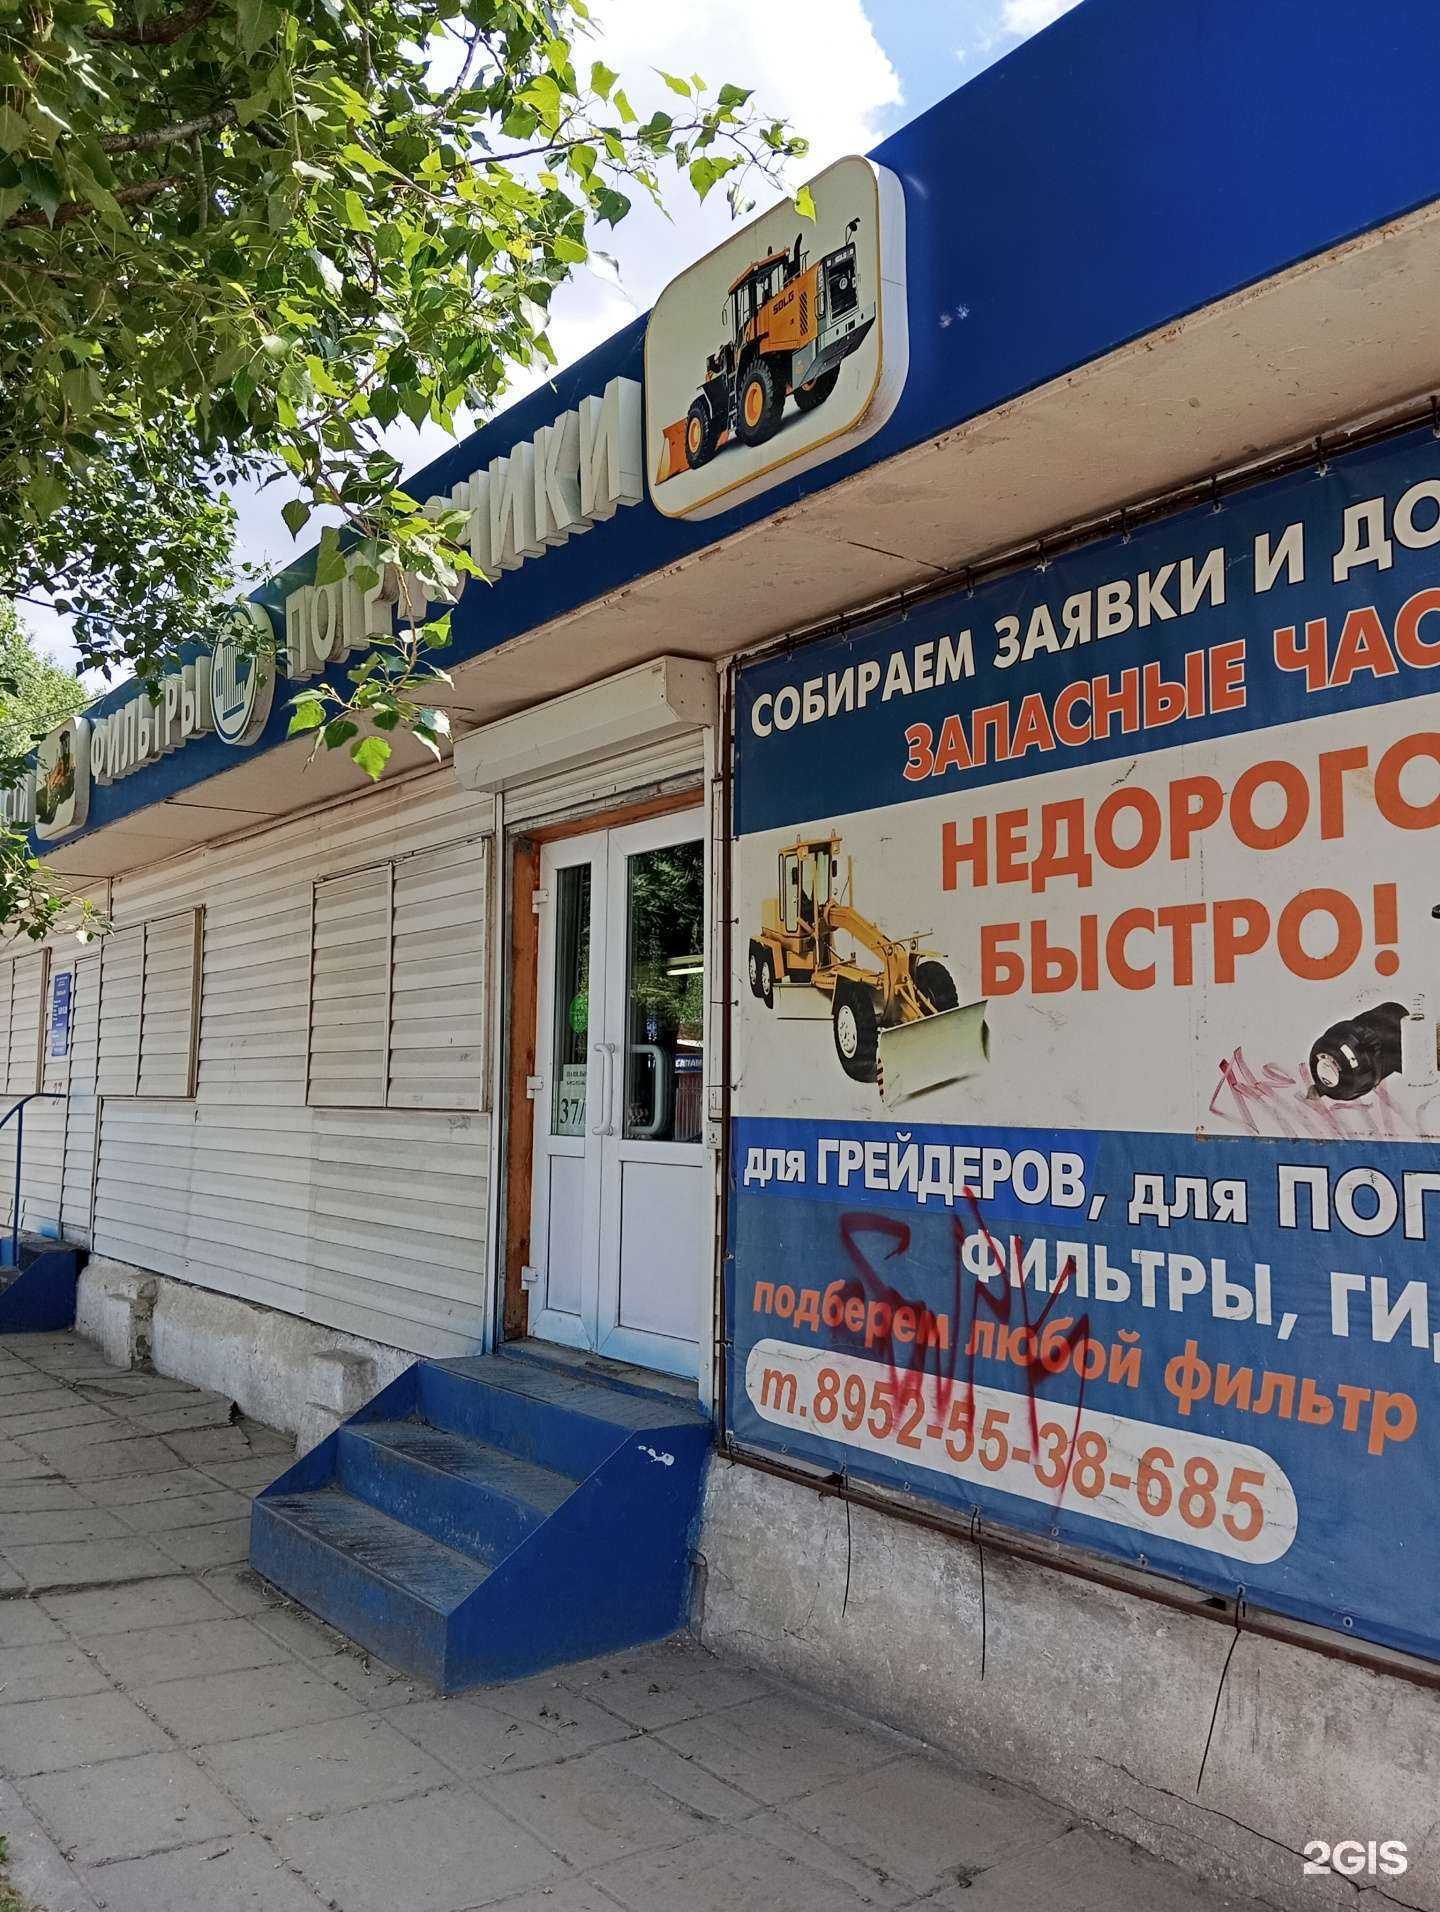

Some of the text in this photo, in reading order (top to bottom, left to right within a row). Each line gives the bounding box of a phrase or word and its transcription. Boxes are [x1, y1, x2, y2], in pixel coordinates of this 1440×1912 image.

[750, 629, 975, 738] СОБИРАЕМ
[992, 550, 1226, 669] ЗАЯВКИ
[1253, 521, 1305, 594] И
[902, 586, 1440, 783] ЗАПАСНЫЕ ЧАС
[941, 731, 1440, 893] НЕДОРОГО
[980, 882, 1400, 996] БЫСТРО!
[743, 1146, 806, 1188] для
[816, 1130, 1106, 1221] ГРЕЙДЕРОВ,
[1127, 1173, 1247, 1227] для
[961, 1229, 1298, 1340] ФИЛЬТРЫ,
[752, 1278, 1417, 1456] подберем любой фильтр
